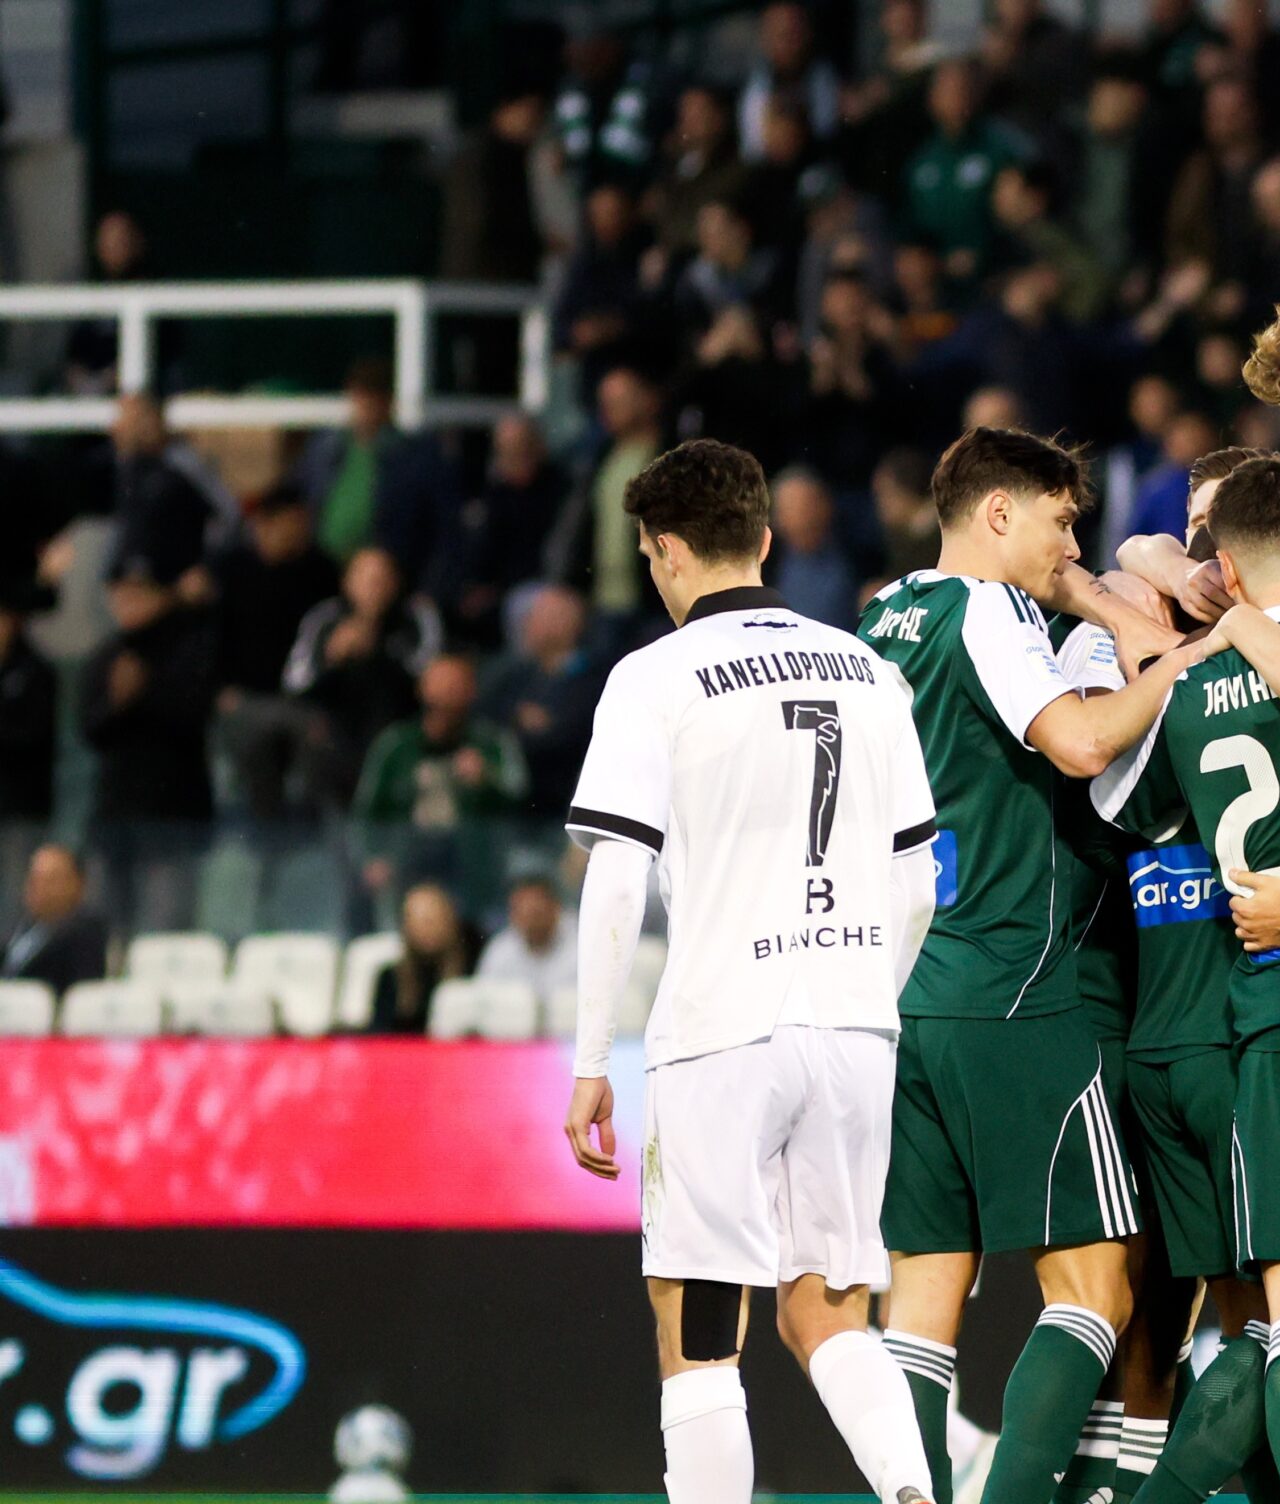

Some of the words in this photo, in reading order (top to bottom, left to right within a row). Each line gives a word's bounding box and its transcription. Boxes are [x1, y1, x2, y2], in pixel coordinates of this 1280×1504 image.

[695, 651, 876, 698] KANELLOPOULOS
[1203, 673, 1249, 718] JAVI
[1247, 670, 1279, 704] H
[781, 700, 843, 867] 7
[753, 926, 883, 960] BIANCHE
